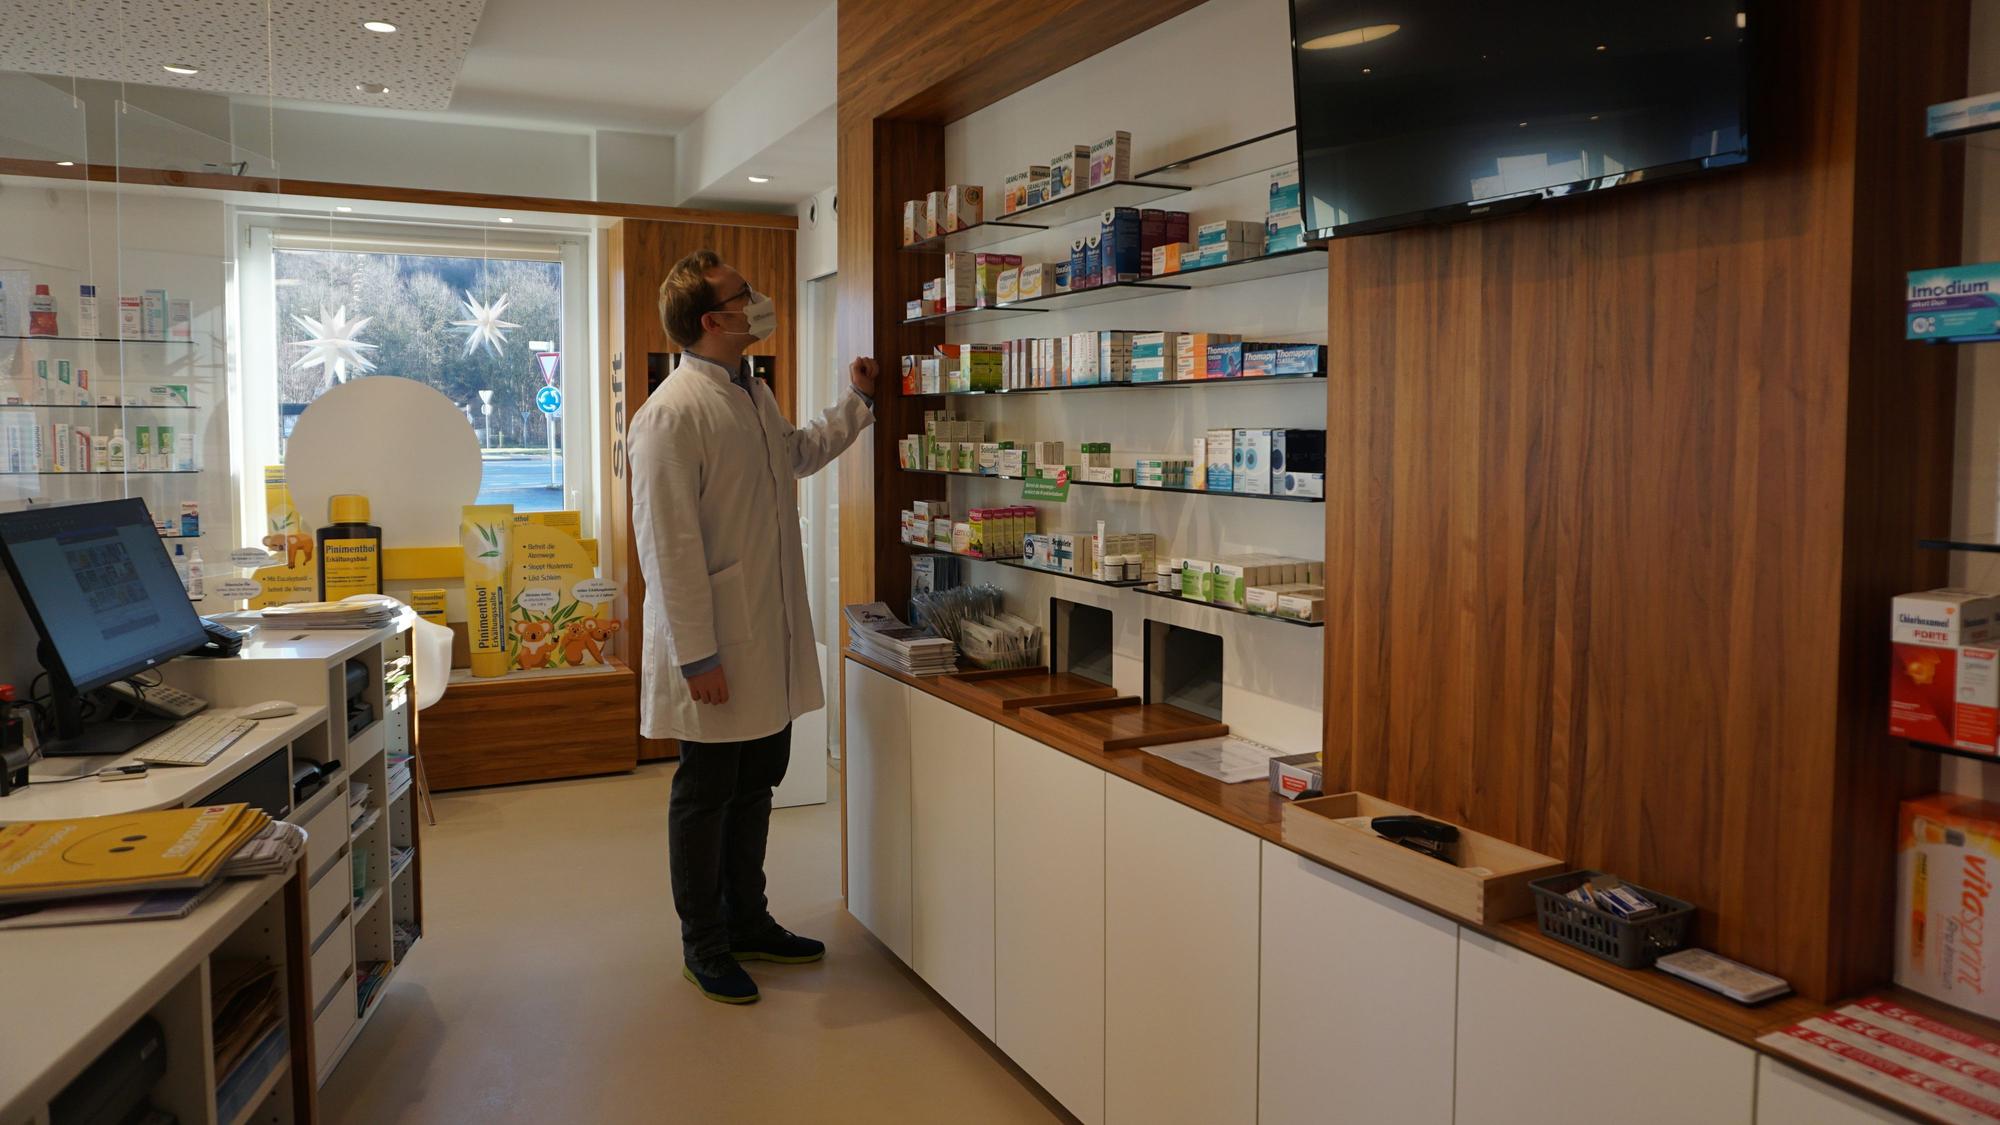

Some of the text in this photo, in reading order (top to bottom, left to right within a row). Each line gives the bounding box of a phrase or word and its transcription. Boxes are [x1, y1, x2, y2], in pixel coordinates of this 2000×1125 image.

[1912, 280, 1989, 298] Imodium
[1207, 345, 1240, 356] Thomapyrin
[1276, 349, 1316, 360] Thomapyrin
[612, 352, 624, 479] Saft
[326, 543, 375, 554] Pinimenthol
[528, 563, 545, 571] Stoppt
[478, 586, 489, 649] Pinimenthol
[491, 591, 499, 649] Erkältungssalbe
[1899, 613, 1950, 628] Chlorhexamed
[1914, 629, 1949, 641] FORTE
[1952, 854, 1993, 994] vitasprint
